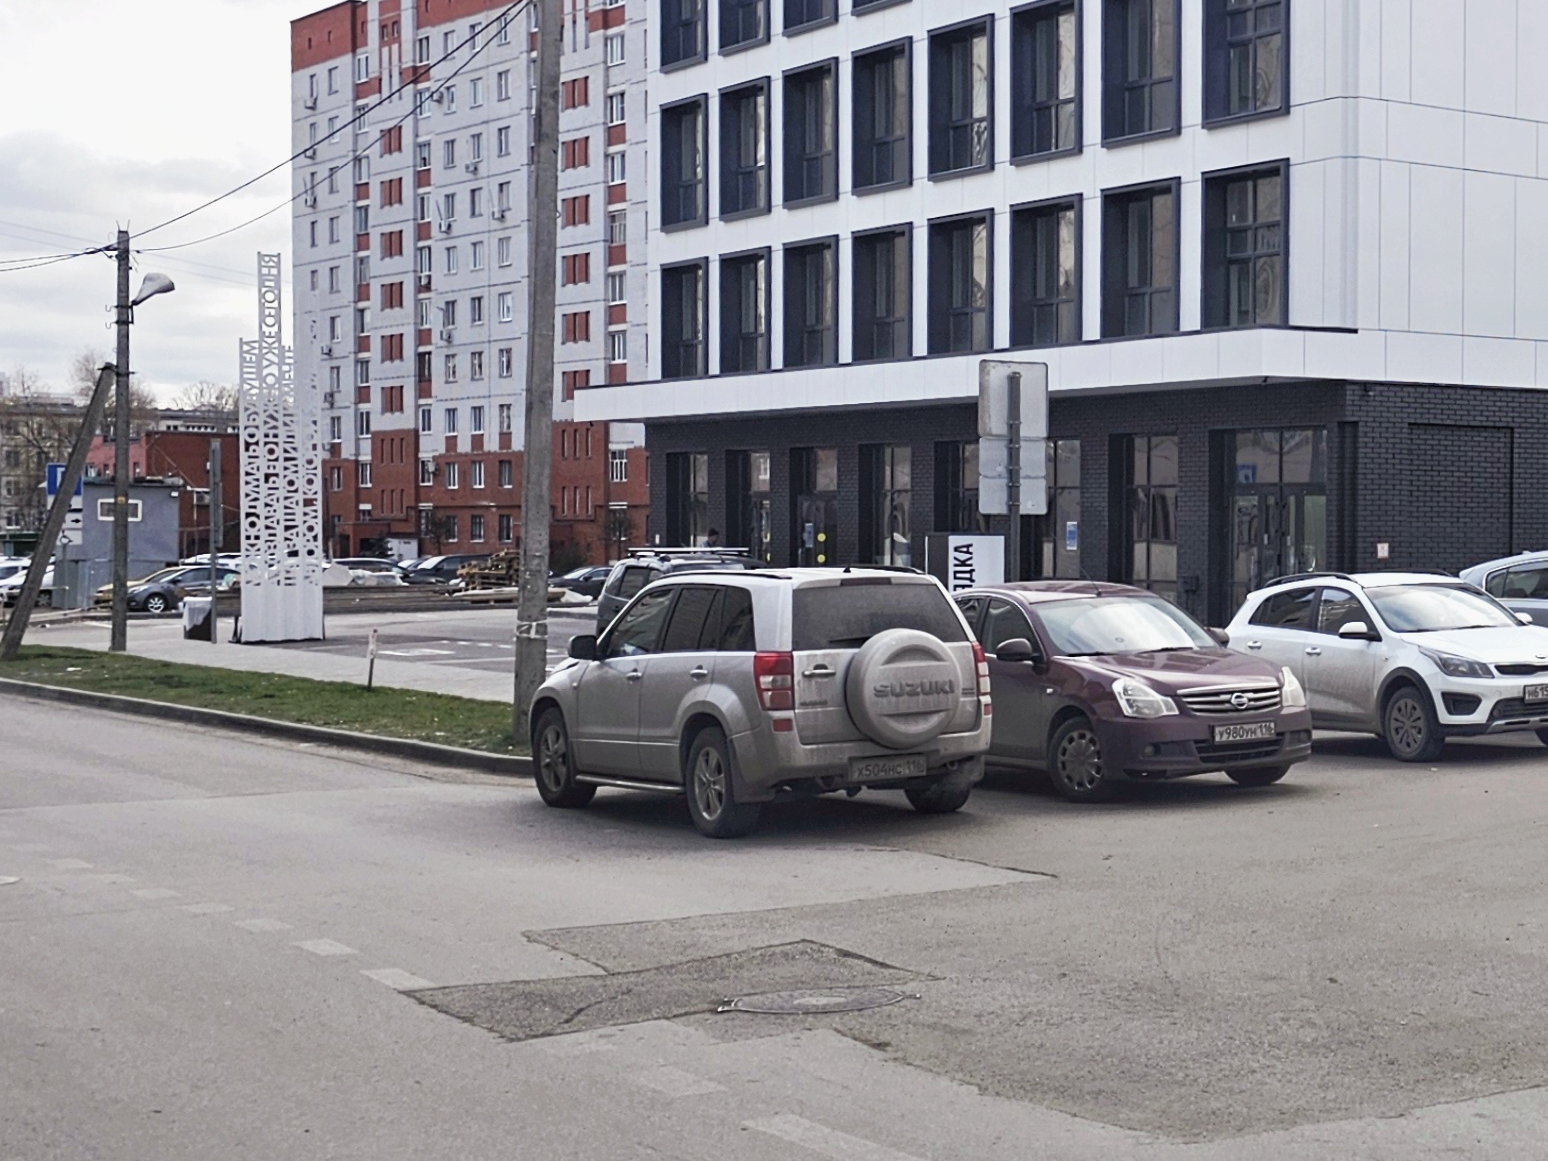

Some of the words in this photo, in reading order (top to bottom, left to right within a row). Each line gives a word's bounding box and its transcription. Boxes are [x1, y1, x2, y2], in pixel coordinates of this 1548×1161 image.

[261, 254, 279, 327] СЕГОДНЯ
[262, 331, 279, 369] УЖЕ
[873, 679, 955, 698] SUZUKI
